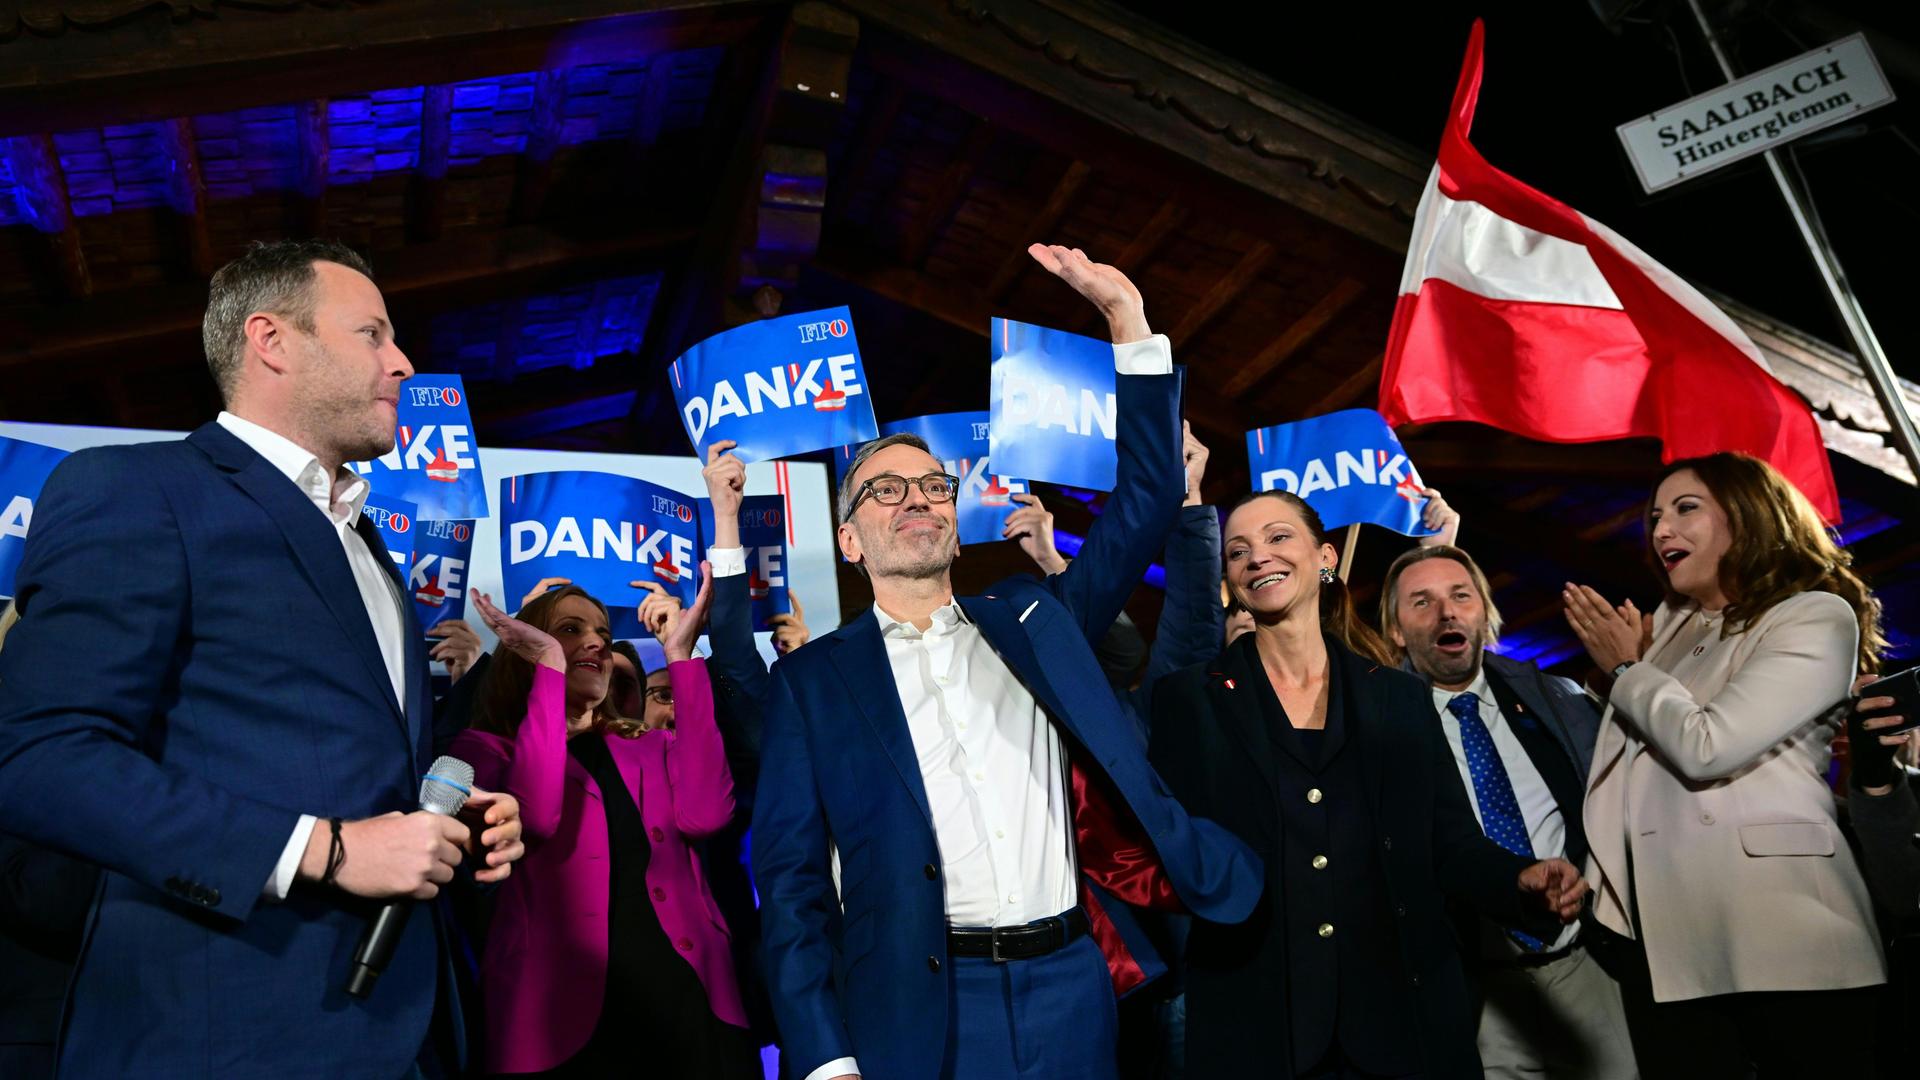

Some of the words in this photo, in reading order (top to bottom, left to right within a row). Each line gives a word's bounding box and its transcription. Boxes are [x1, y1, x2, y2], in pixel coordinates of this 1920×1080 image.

[1657, 60, 1847, 149] SAALBACH
[1673, 89, 1853, 167] Hinterglemm
[684, 353, 862, 446] DANKE
[1261, 449, 1425, 499] DANK
[510, 517, 692, 580] DANKE
